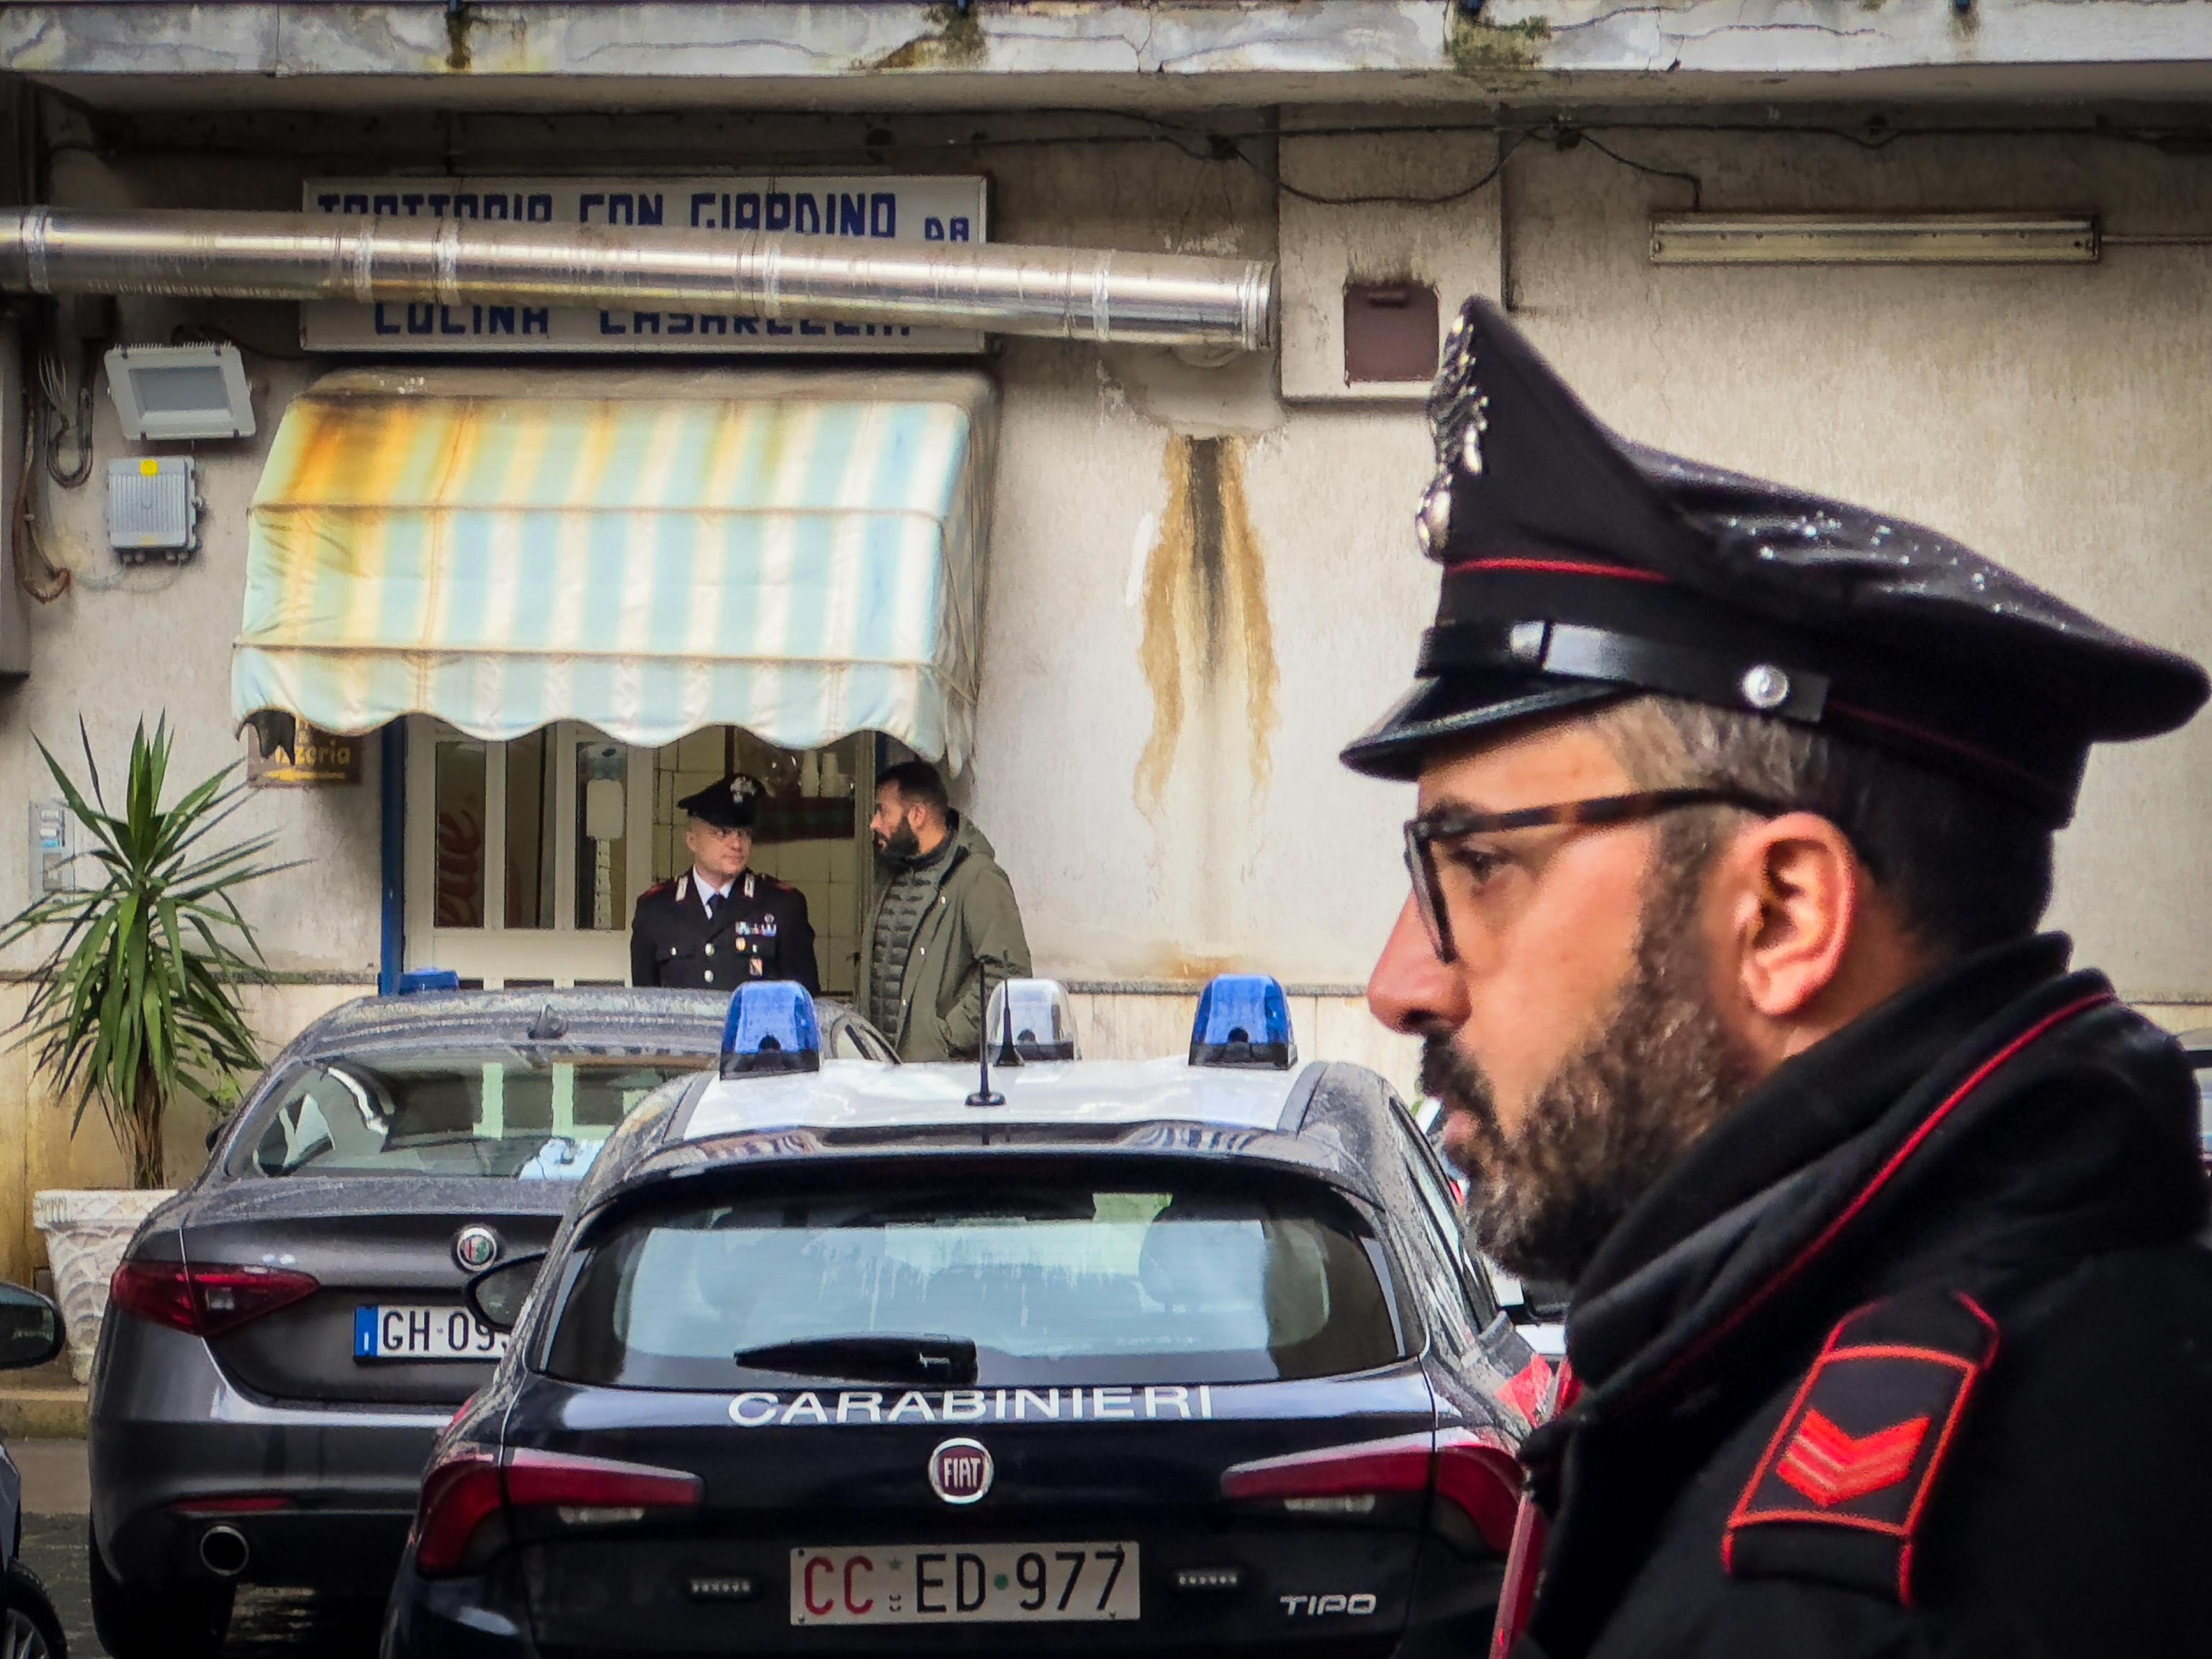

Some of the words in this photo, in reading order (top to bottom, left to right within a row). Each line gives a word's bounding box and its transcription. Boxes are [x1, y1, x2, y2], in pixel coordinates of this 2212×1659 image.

[691, 192, 896, 238] GIARDINO
[925, 216, 969, 242] DA
[382, 1310, 430, 1351] GH
[448, 1311, 508, 1352] 09
[728, 1385, 1212, 1426] CARABINIERI
[943, 1457, 981, 1488] FIAT
[804, 1555, 874, 1615] CC
[916, 1552, 986, 1614] ED
[1016, 1551, 1125, 1611] 977
[1280, 1593, 1377, 1616] TIPO
